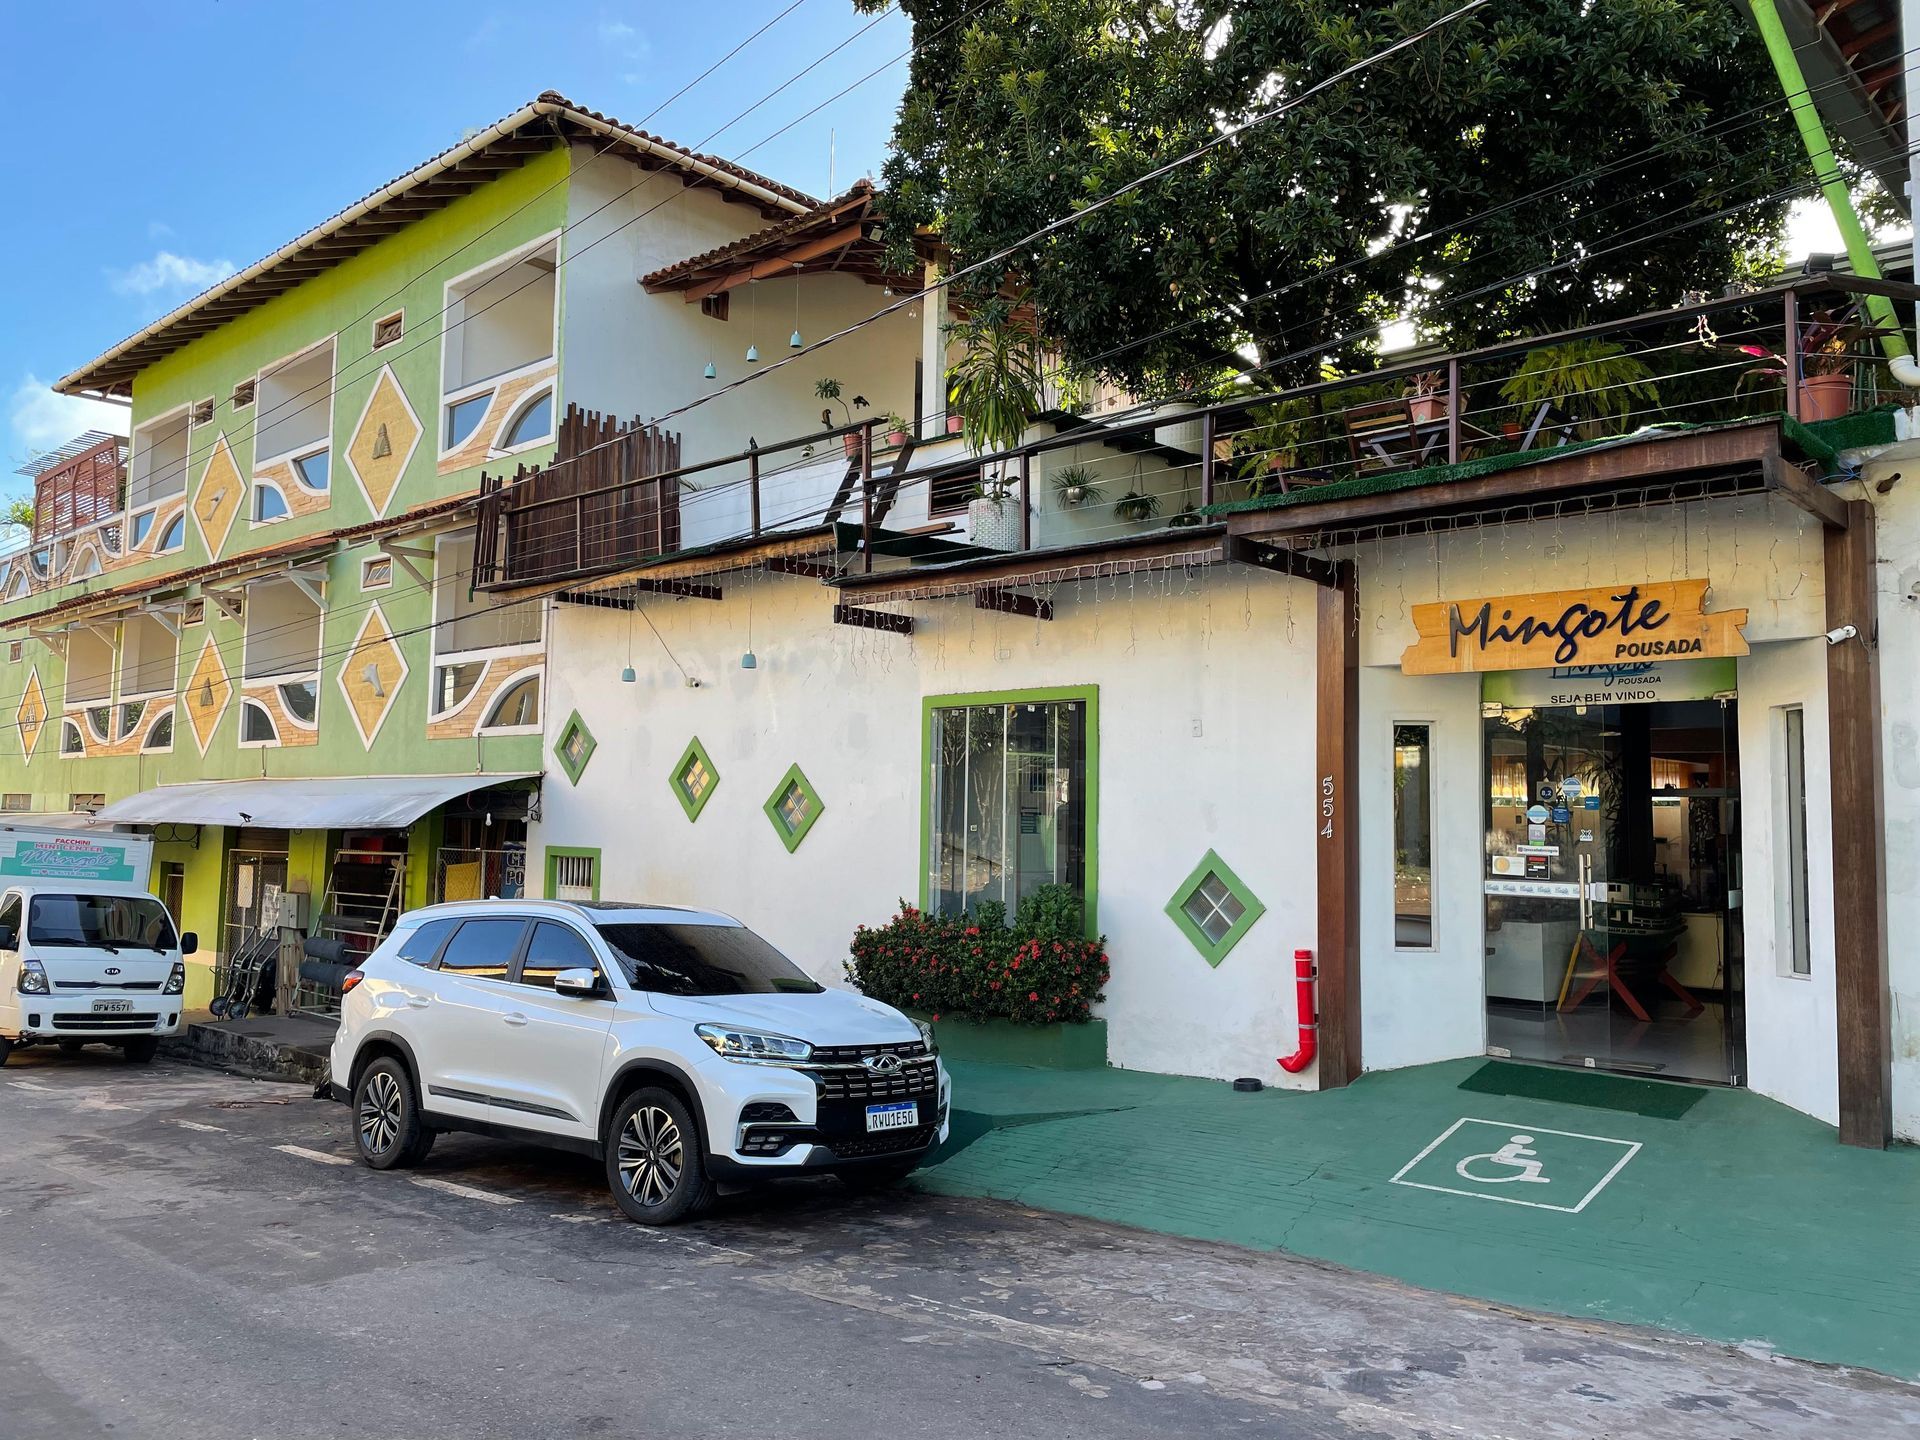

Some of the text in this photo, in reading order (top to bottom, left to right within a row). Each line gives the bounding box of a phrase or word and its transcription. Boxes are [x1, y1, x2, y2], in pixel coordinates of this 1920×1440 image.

[1450, 587, 1670, 664] Mingote
[1615, 638, 1702, 658] POUSADA
[1618, 676, 1662, 685] POUSADA
[1550, 690, 1656, 704] SEJA BEM VINDO
[1321, 774, 1335, 839] 554
[35, 843, 103, 853] MINI CENTER
[55, 838, 91, 846] FACCHINI
[19, 849, 119, 872] Mingote
[872, 1110, 914, 1129] RWU1E50
